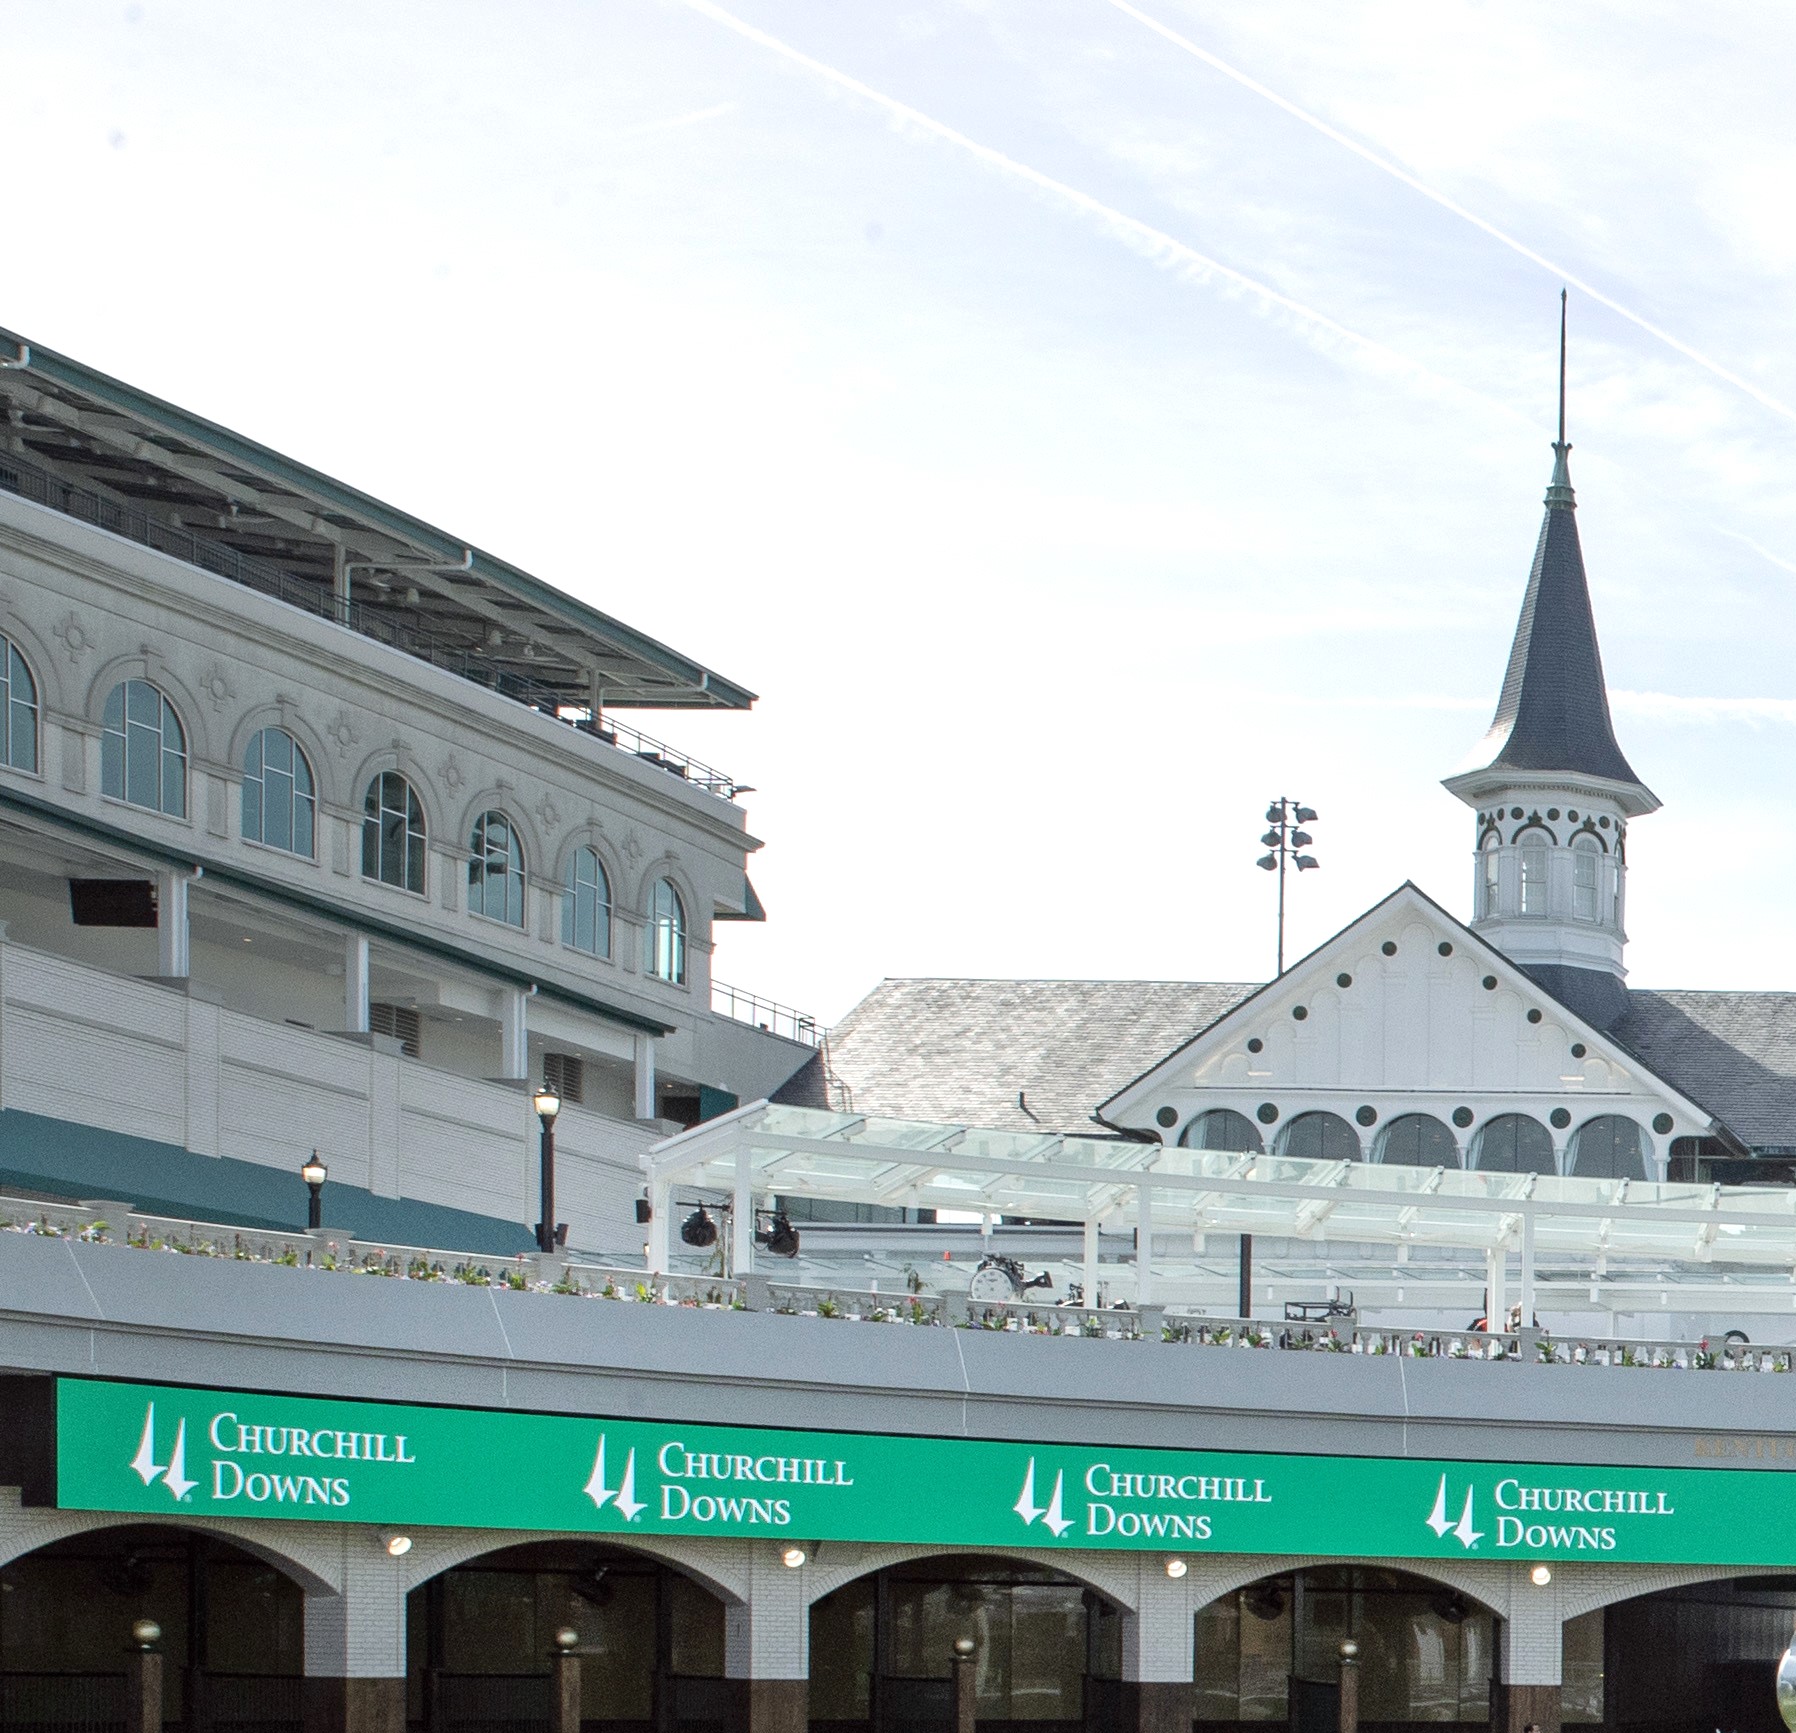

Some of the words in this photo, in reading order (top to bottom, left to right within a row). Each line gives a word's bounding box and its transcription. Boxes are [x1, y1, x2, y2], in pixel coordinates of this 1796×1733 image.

[208, 1412, 416, 1463] CHURCHILL
[211, 1460, 350, 1506] DOWNS
[657, 1441, 854, 1486] CHURCHILL
[1085, 1463, 1272, 1503] CHURCHILL
[660, 1484, 790, 1525] DOWNS
[1494, 1478, 1675, 1515] CHURCHILL
[1086, 1502, 1212, 1540] DOWNS
[1496, 1516, 1616, 1550] DOWNS
